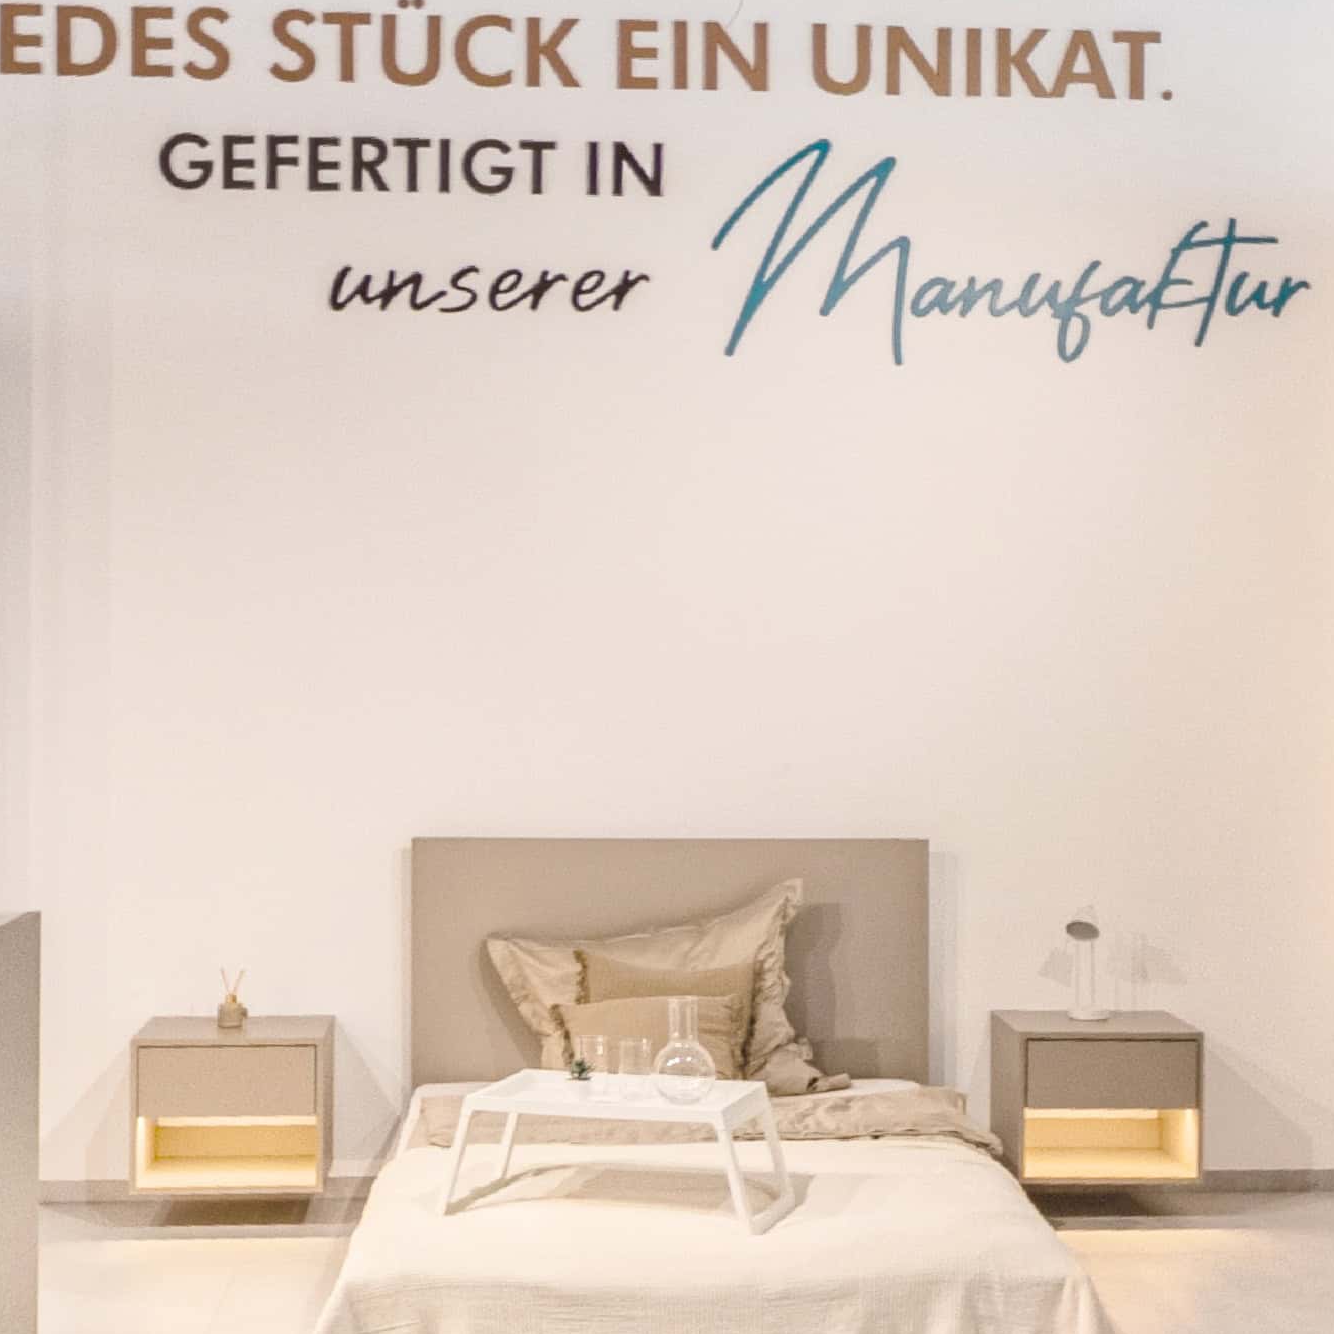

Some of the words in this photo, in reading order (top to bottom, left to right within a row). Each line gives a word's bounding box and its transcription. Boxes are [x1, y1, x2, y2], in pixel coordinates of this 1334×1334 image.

[617, 19, 769, 91] EIN
[812, 23, 1173, 101] UNIKAT.
[159, 132, 557, 196] GEFERTIGT
[587, 141, 663, 197] IN
[328, 265, 650, 313] unserer
[711, 139, 1311, 365] Manufaktur
